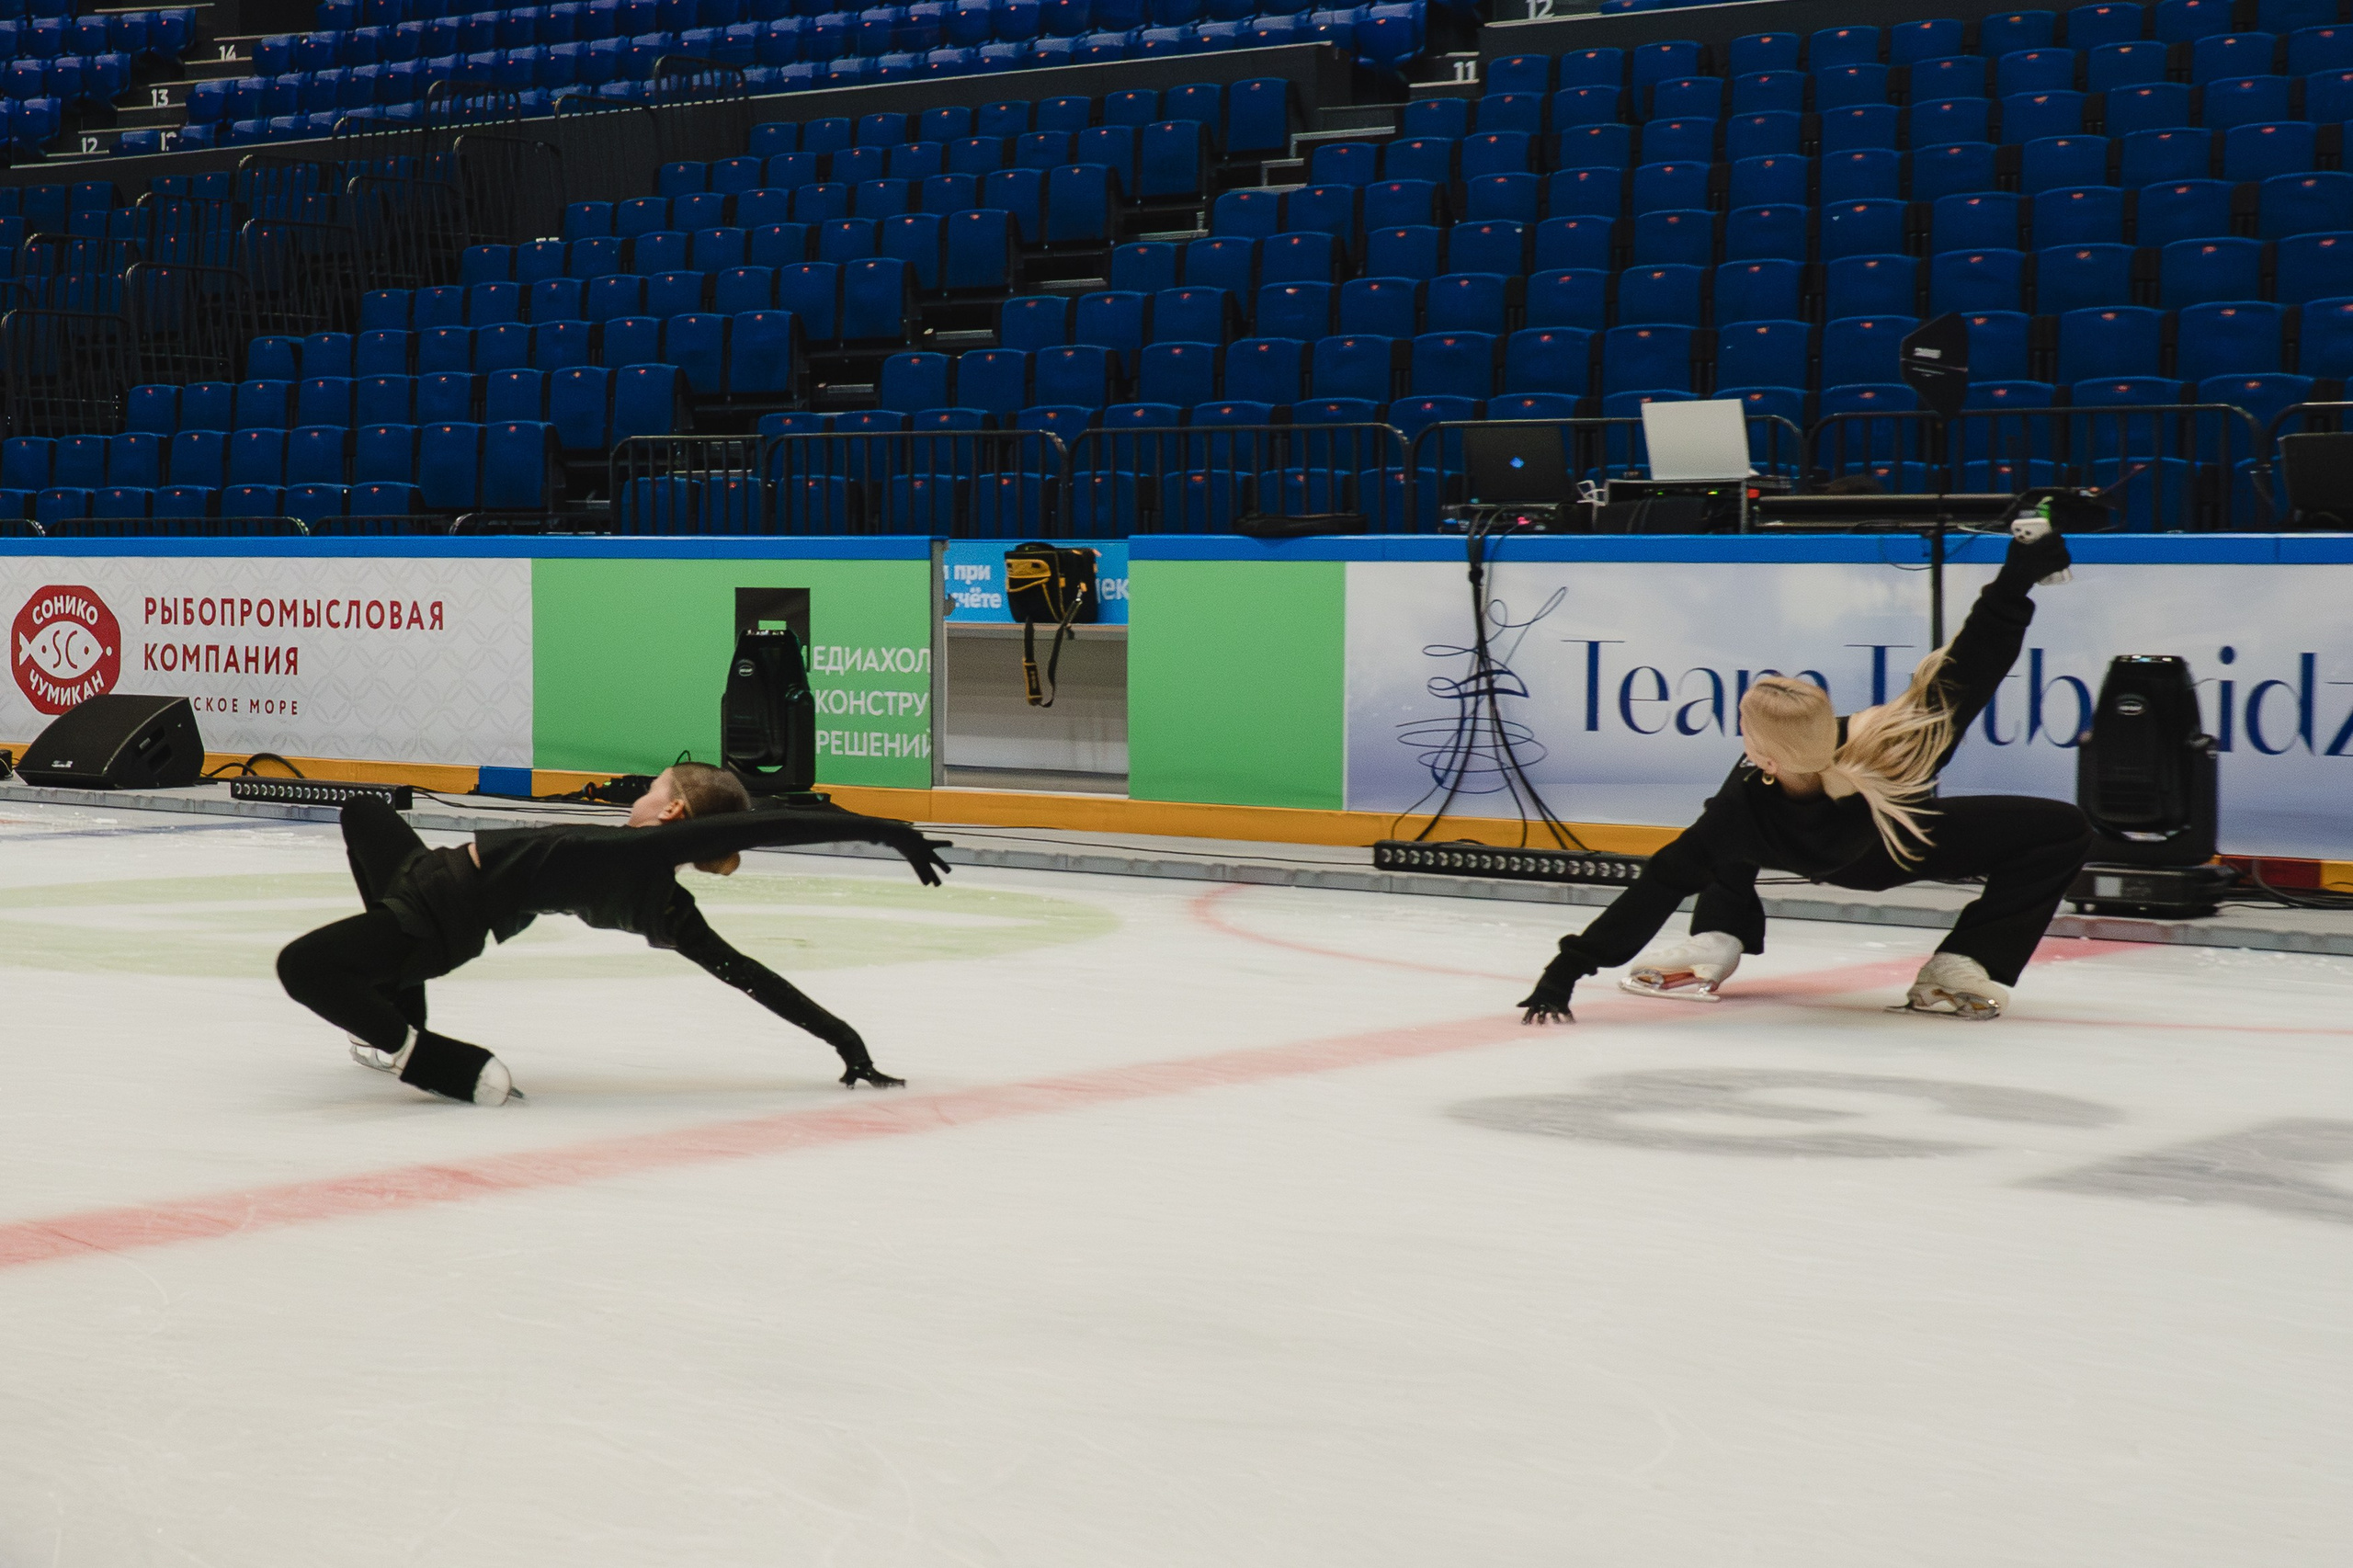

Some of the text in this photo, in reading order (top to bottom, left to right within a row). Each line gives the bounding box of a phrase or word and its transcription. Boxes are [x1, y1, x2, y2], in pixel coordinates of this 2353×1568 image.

[1525, 0, 1555, 18] 12
[219, 45, 236, 61] 14
[1453, 61, 1477, 81] 11
[152, 89, 169, 108] 13
[82, 138, 98, 153] 12
[953, 564, 992, 585] при
[32, 595, 98, 625] СОНИКО
[144, 597, 444, 631] РЫБОПРОМЫСЛОВАЯ
[143, 643, 299, 676] КОМПАНИЯ
[813, 645, 931, 676] ЕДИАХОЛ
[28, 669, 105, 707] ЧУМИКАН
[193, 697, 298, 715] СКОЕ МОРЕ
[814, 689, 929, 717] КОНСТРУ
